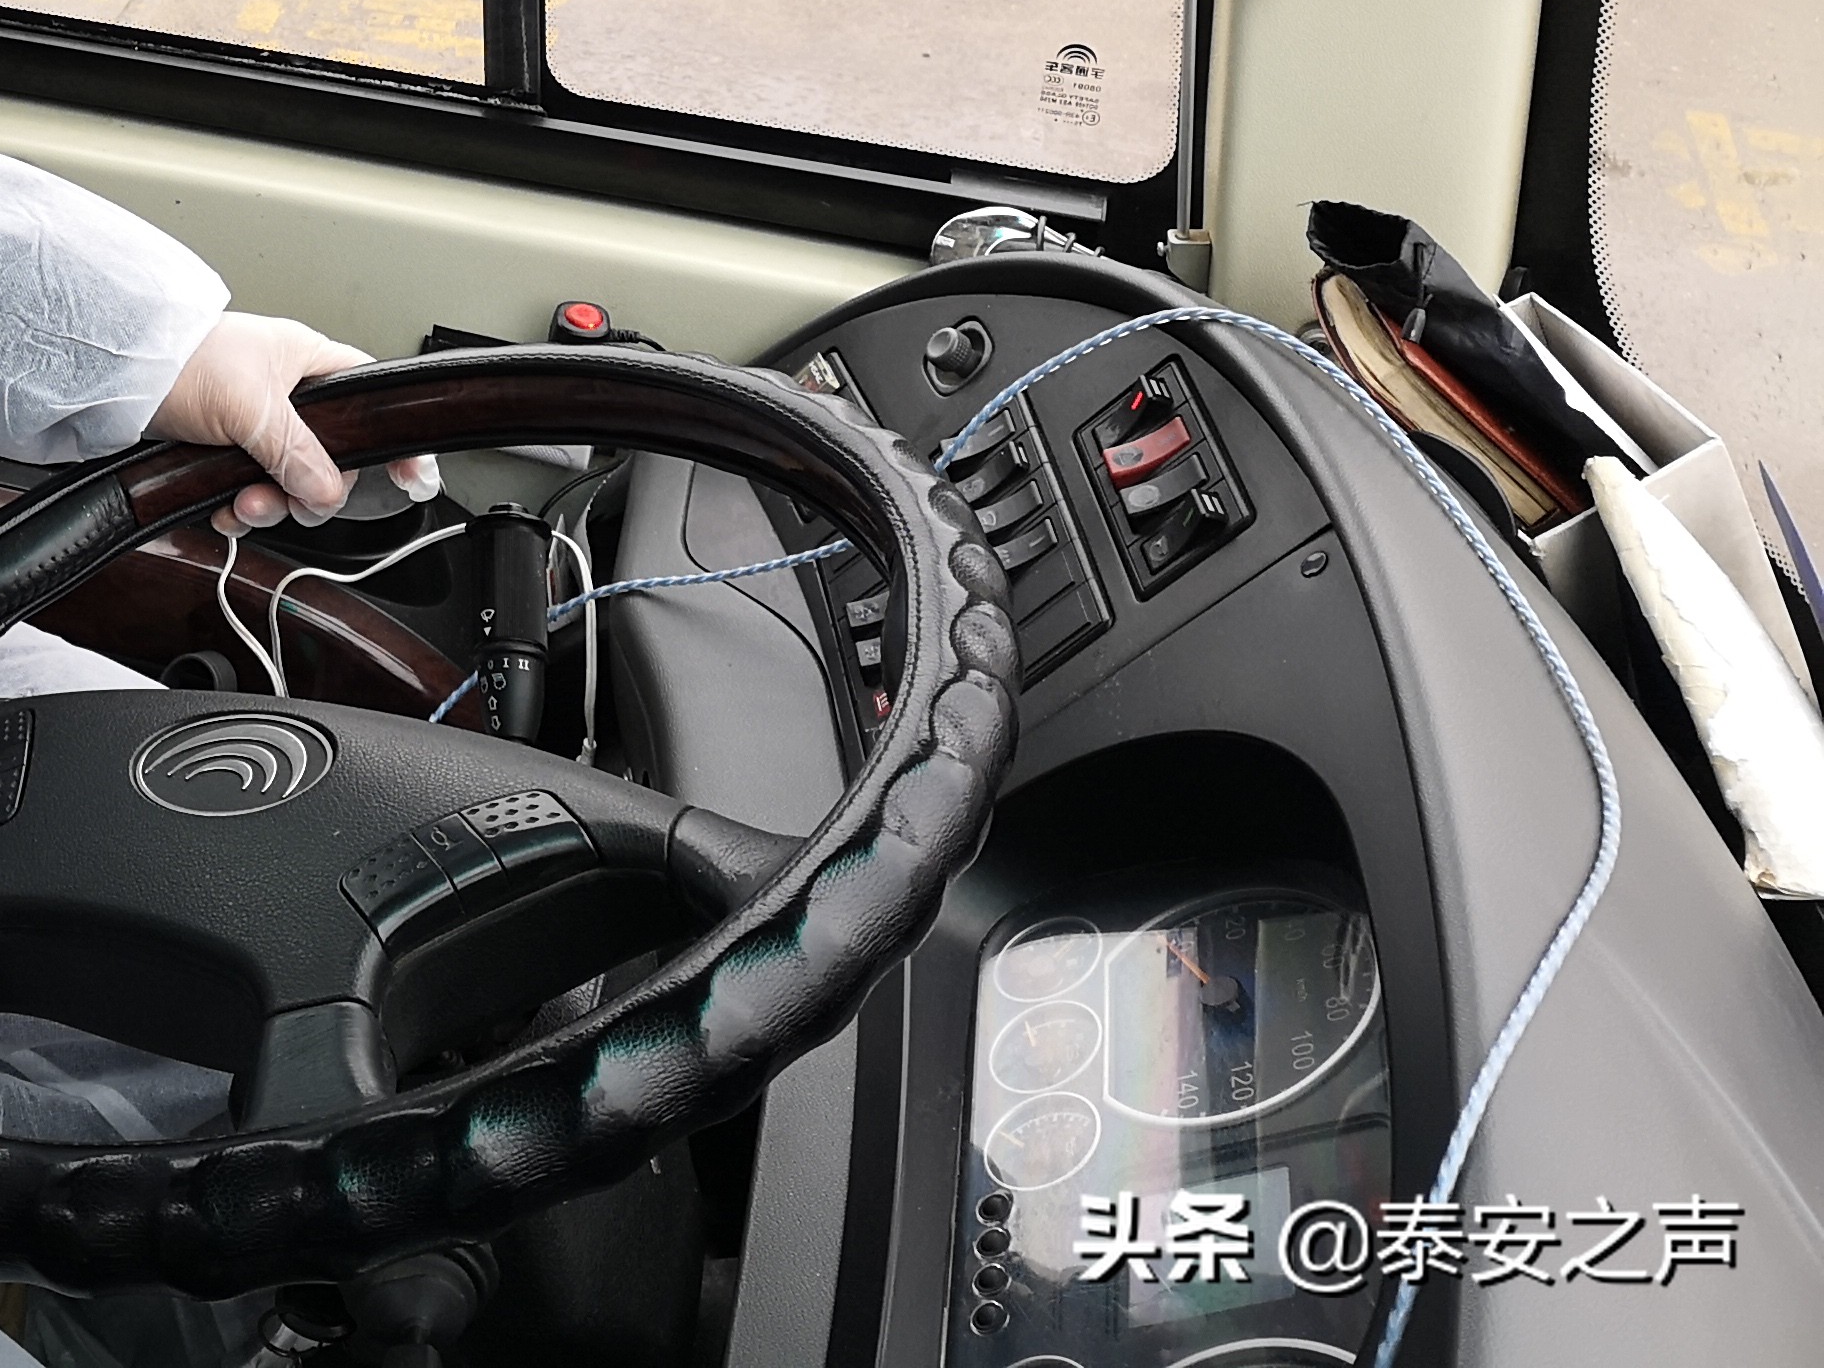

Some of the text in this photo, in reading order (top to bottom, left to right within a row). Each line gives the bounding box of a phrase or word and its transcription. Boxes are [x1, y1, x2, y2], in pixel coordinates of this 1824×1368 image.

[1326, 996, 1350, 1022] 80
[1290, 1030, 1315, 1071] 100
[1175, 1069, 1199, 1110] 140
[1230, 1061, 1255, 1102] 120
